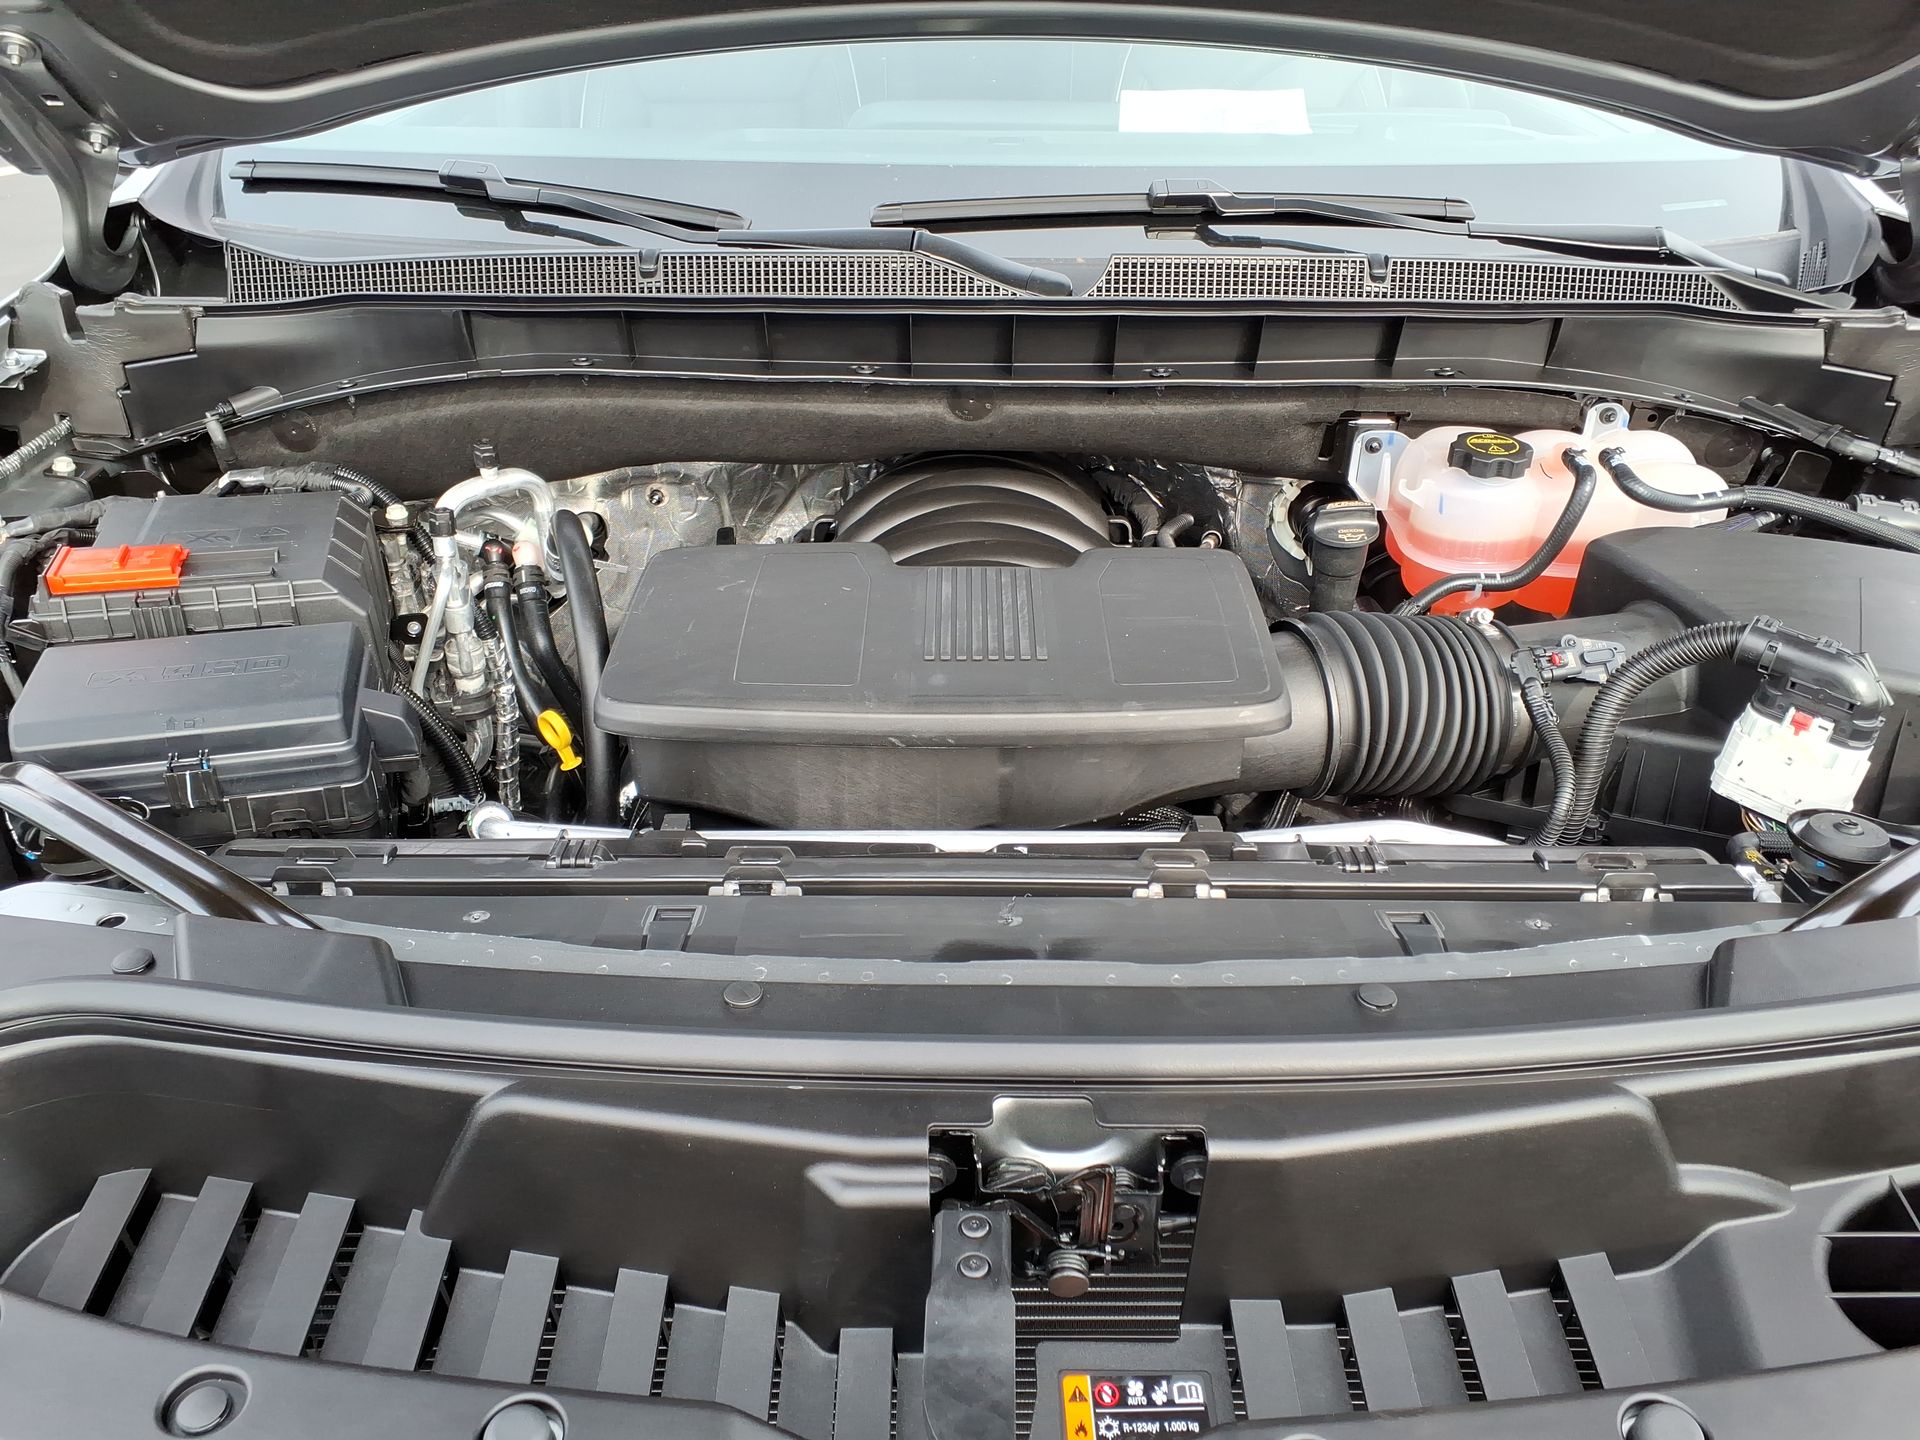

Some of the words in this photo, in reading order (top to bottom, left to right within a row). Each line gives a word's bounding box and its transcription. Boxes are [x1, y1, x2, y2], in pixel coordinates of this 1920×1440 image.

[1127, 1396, 1147, 1406] AUTO
[1123, 1422, 1160, 1434] R-1234yf
[1164, 1421, 1187, 1432] 1.000
[1188, 1421, 1199, 1433] kg
